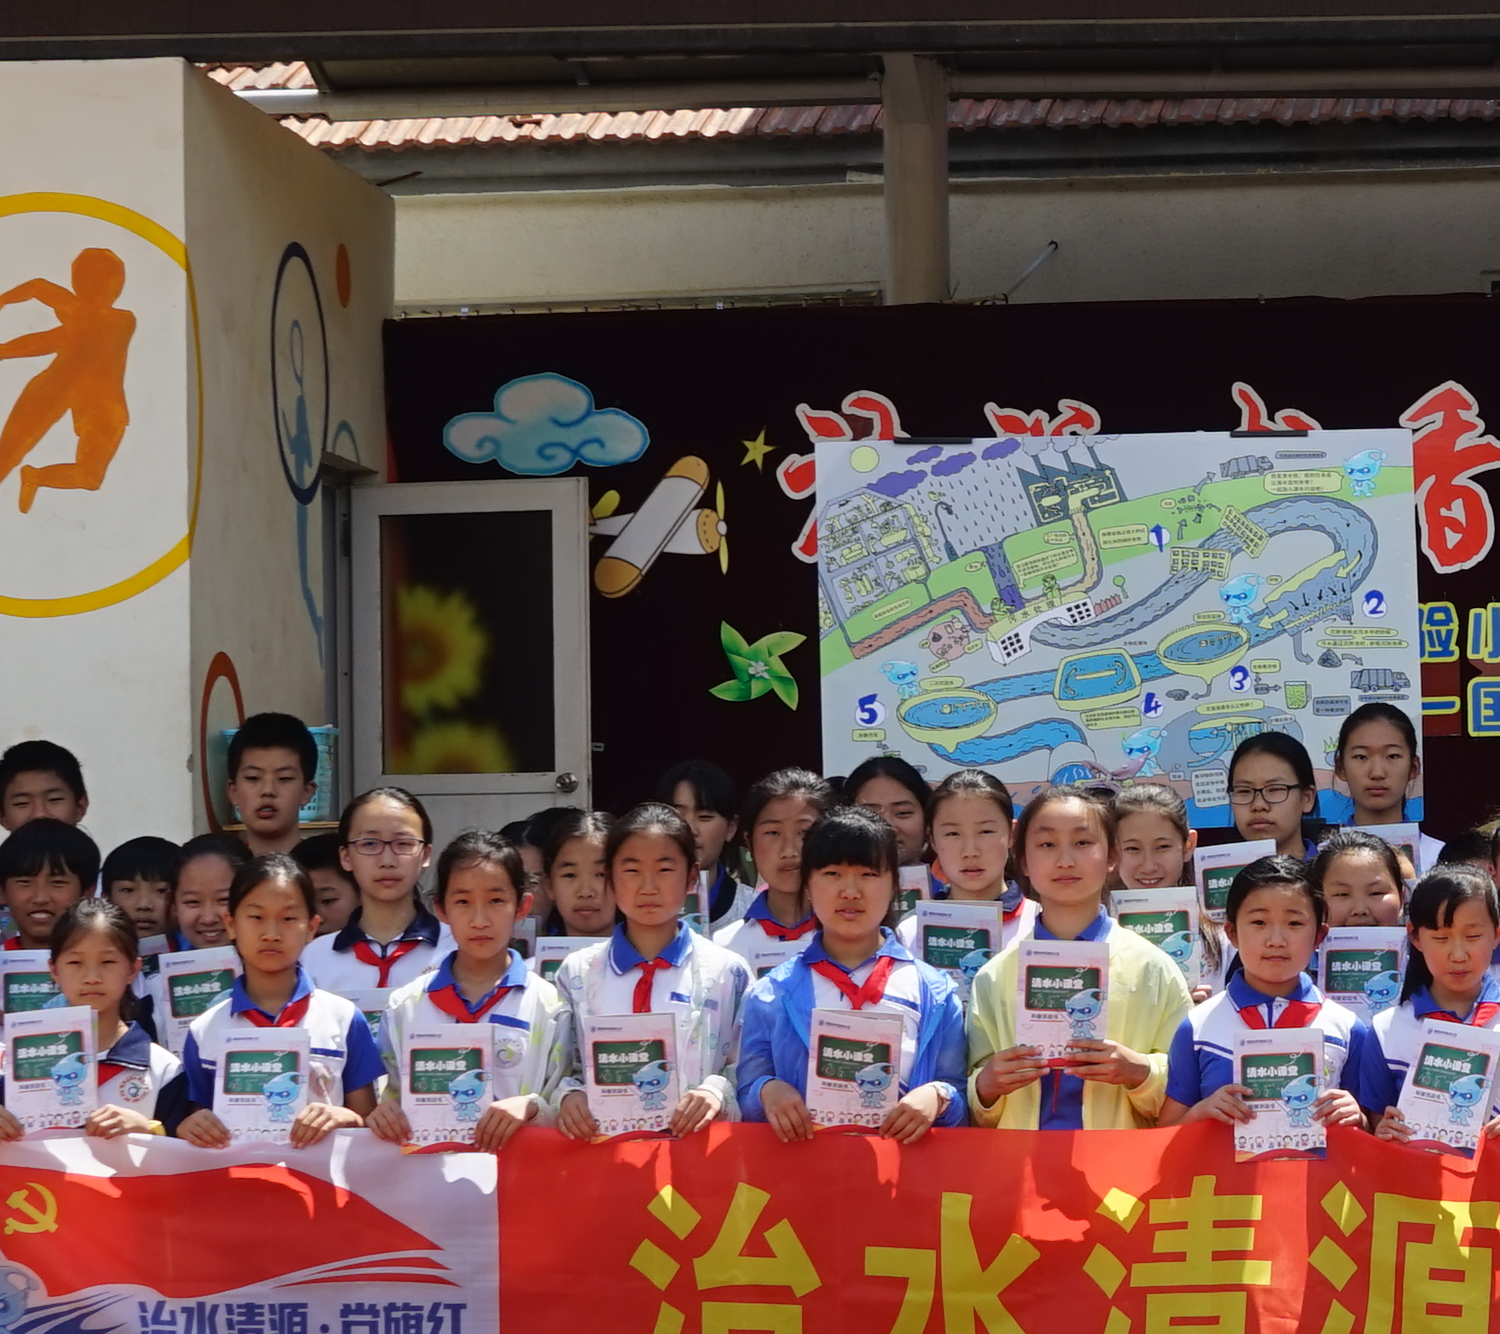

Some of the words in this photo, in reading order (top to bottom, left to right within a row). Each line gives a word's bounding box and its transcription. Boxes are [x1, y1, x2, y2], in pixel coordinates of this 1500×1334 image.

[1364, 589, 1386, 615] 2
[1229, 665, 1250, 690] 3
[858, 693, 879, 724] 5
[1141, 692, 1163, 715] 4
